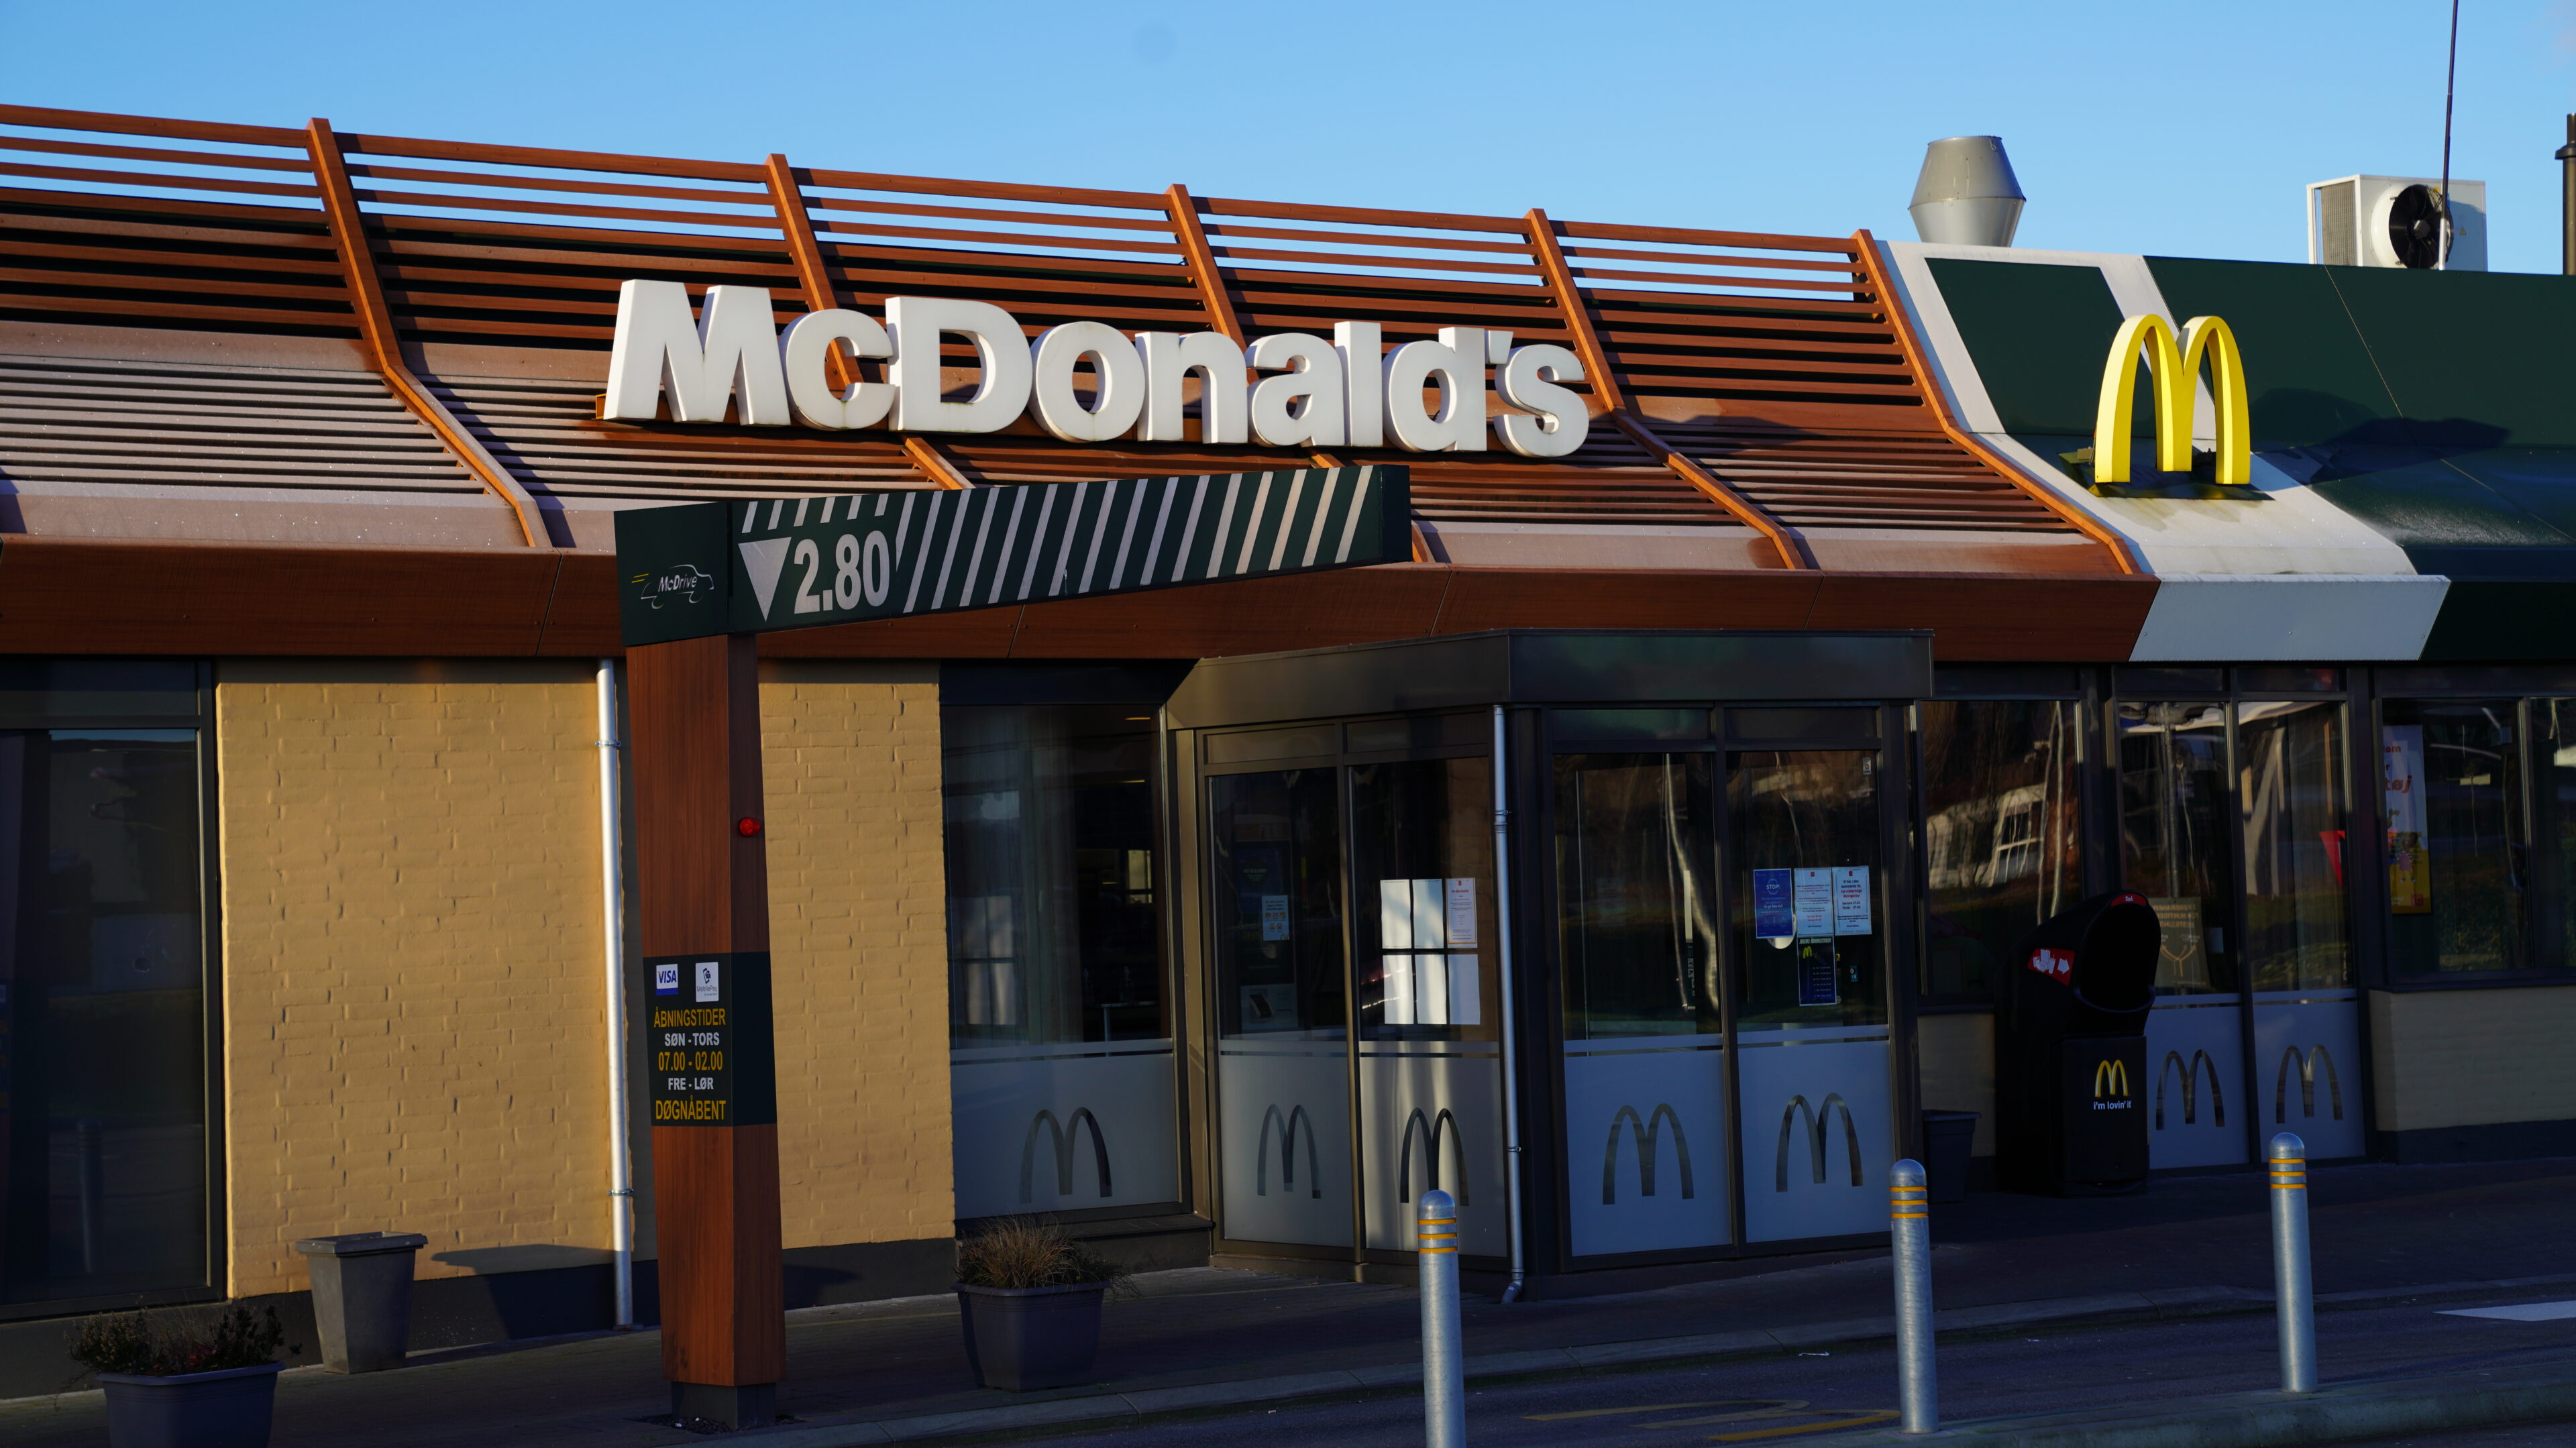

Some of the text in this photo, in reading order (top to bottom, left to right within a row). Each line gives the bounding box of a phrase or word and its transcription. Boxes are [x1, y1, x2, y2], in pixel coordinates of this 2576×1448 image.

[604, 279, 1589, 457] McDonald's
[794, 530, 890, 614] 2.80
[658, 573, 698, 592] McDrive
[657, 970, 677, 984] VISA
[654, 1006, 726, 1028] ÅBNINGSTIDER
[664, 1033, 685, 1046] SØN
[692, 1032, 720, 1046] TORS
[658, 1051, 686, 1071] 07.00
[695, 1051, 723, 1071] 02.00
[668, 1078, 686, 1091] FRE
[694, 1077, 714, 1090] LØR
[655, 1095, 726, 1120] DØGNÅBENT
[2094, 1100, 2132, 1110] i'm lovin' it
